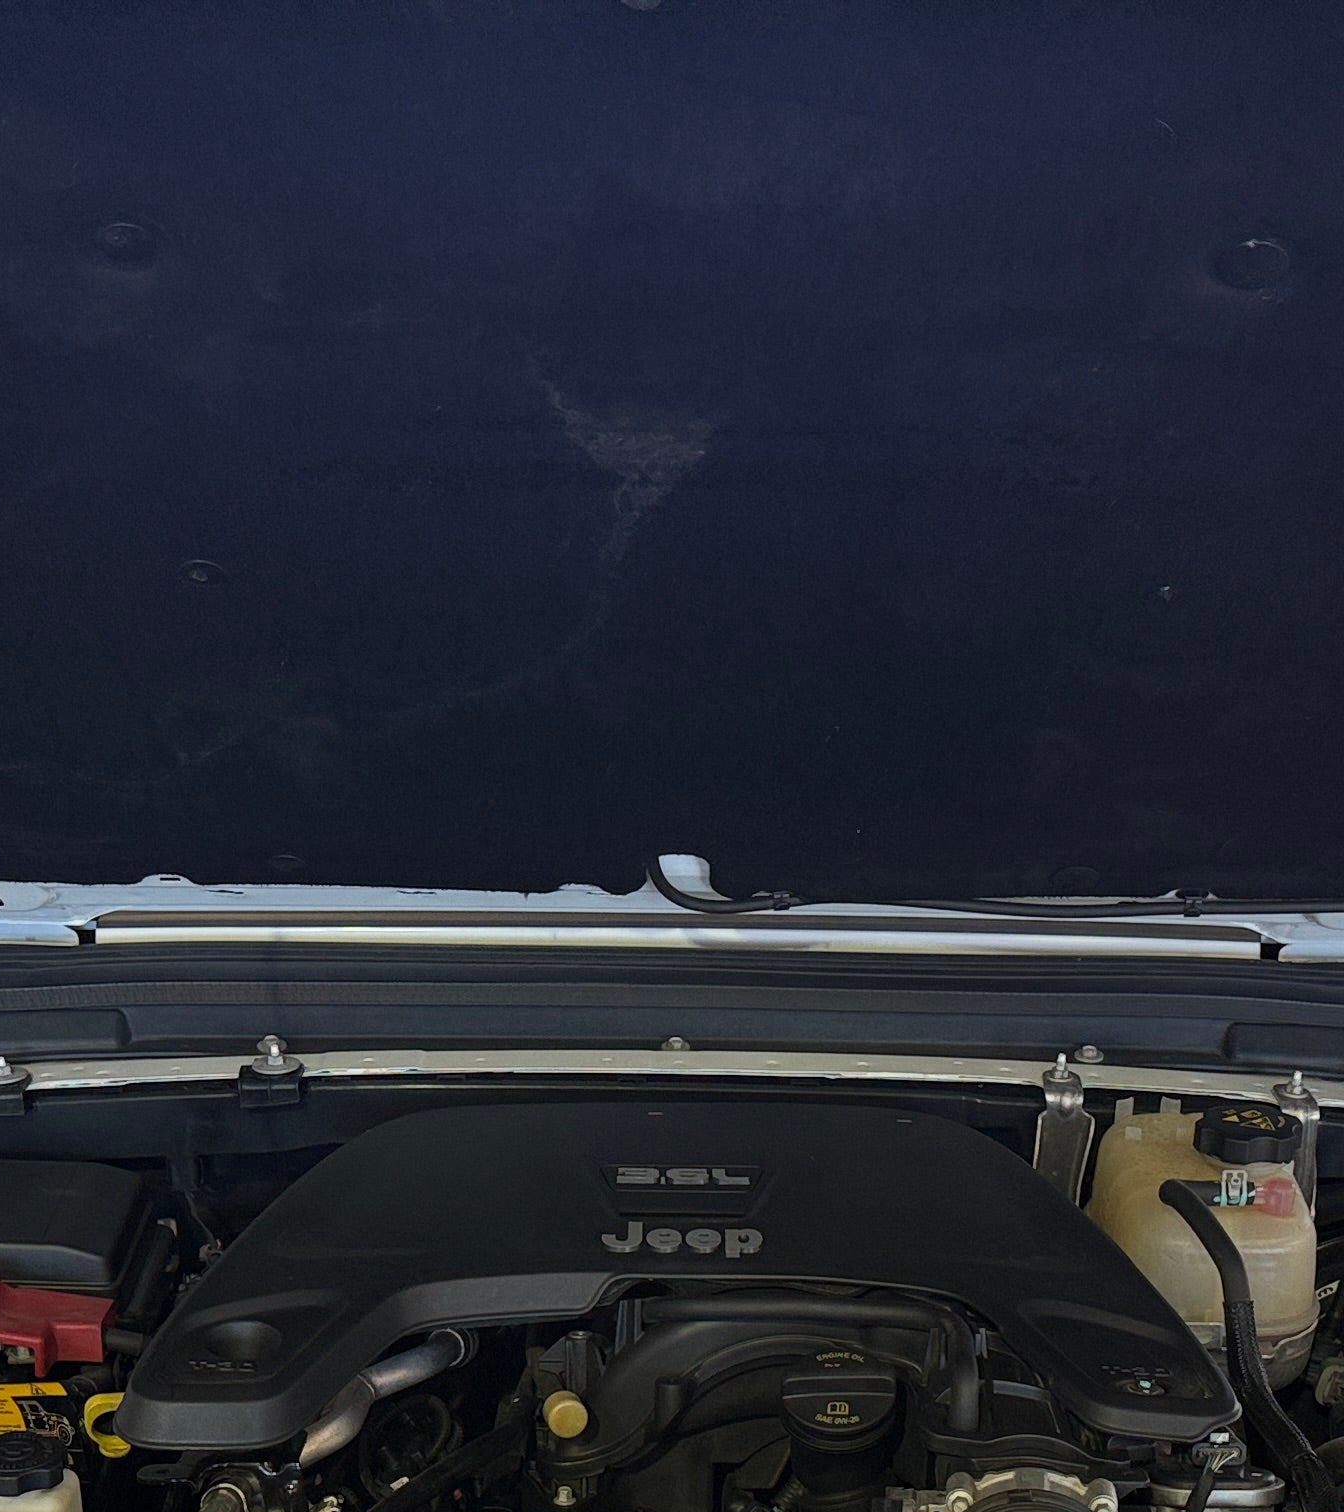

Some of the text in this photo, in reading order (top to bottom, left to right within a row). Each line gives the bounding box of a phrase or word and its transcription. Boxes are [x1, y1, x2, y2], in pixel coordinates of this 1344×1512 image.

[600, 1221, 764, 1258] Jeep
[816, 1351, 865, 1364] ENGINE OIL
